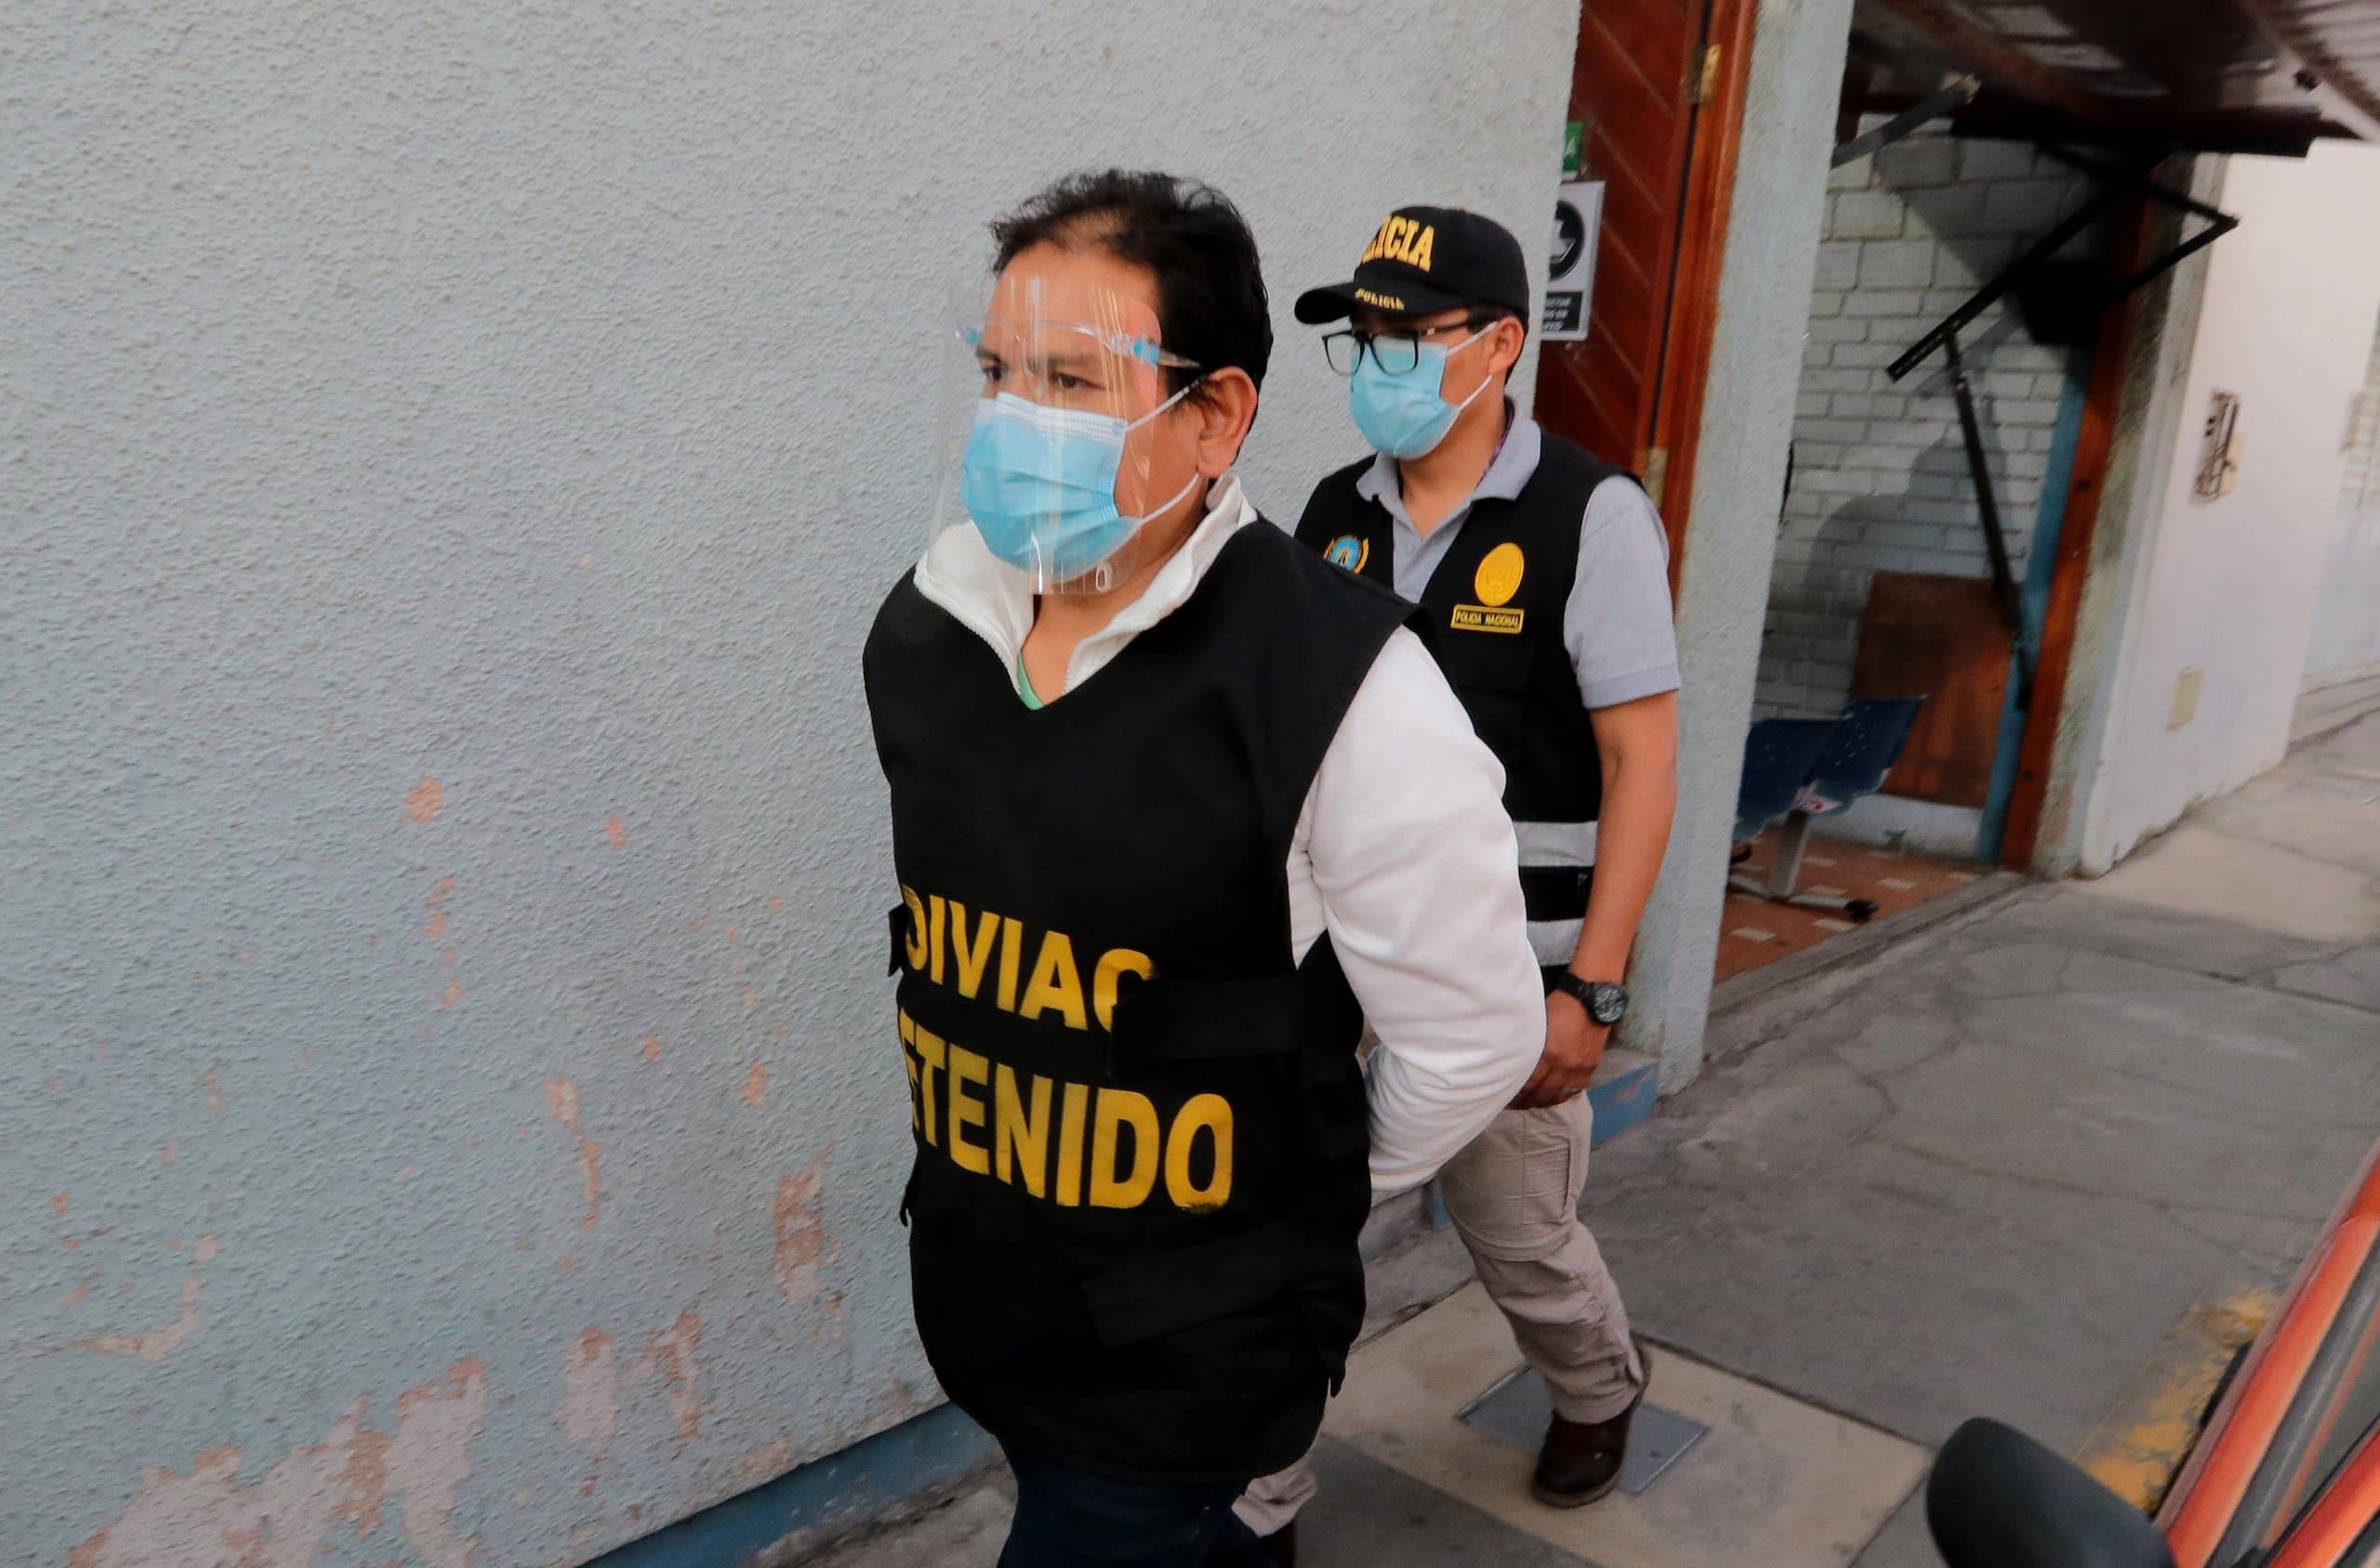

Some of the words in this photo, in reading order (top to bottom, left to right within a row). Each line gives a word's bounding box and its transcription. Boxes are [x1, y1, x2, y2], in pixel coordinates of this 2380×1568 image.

[1359, 215, 1435, 272] LICIA
[1355, 287, 1404, 310] POLICIA
[1457, 610, 1482, 625] POLICIA
[1485, 613, 1519, 627] NACIONAL
